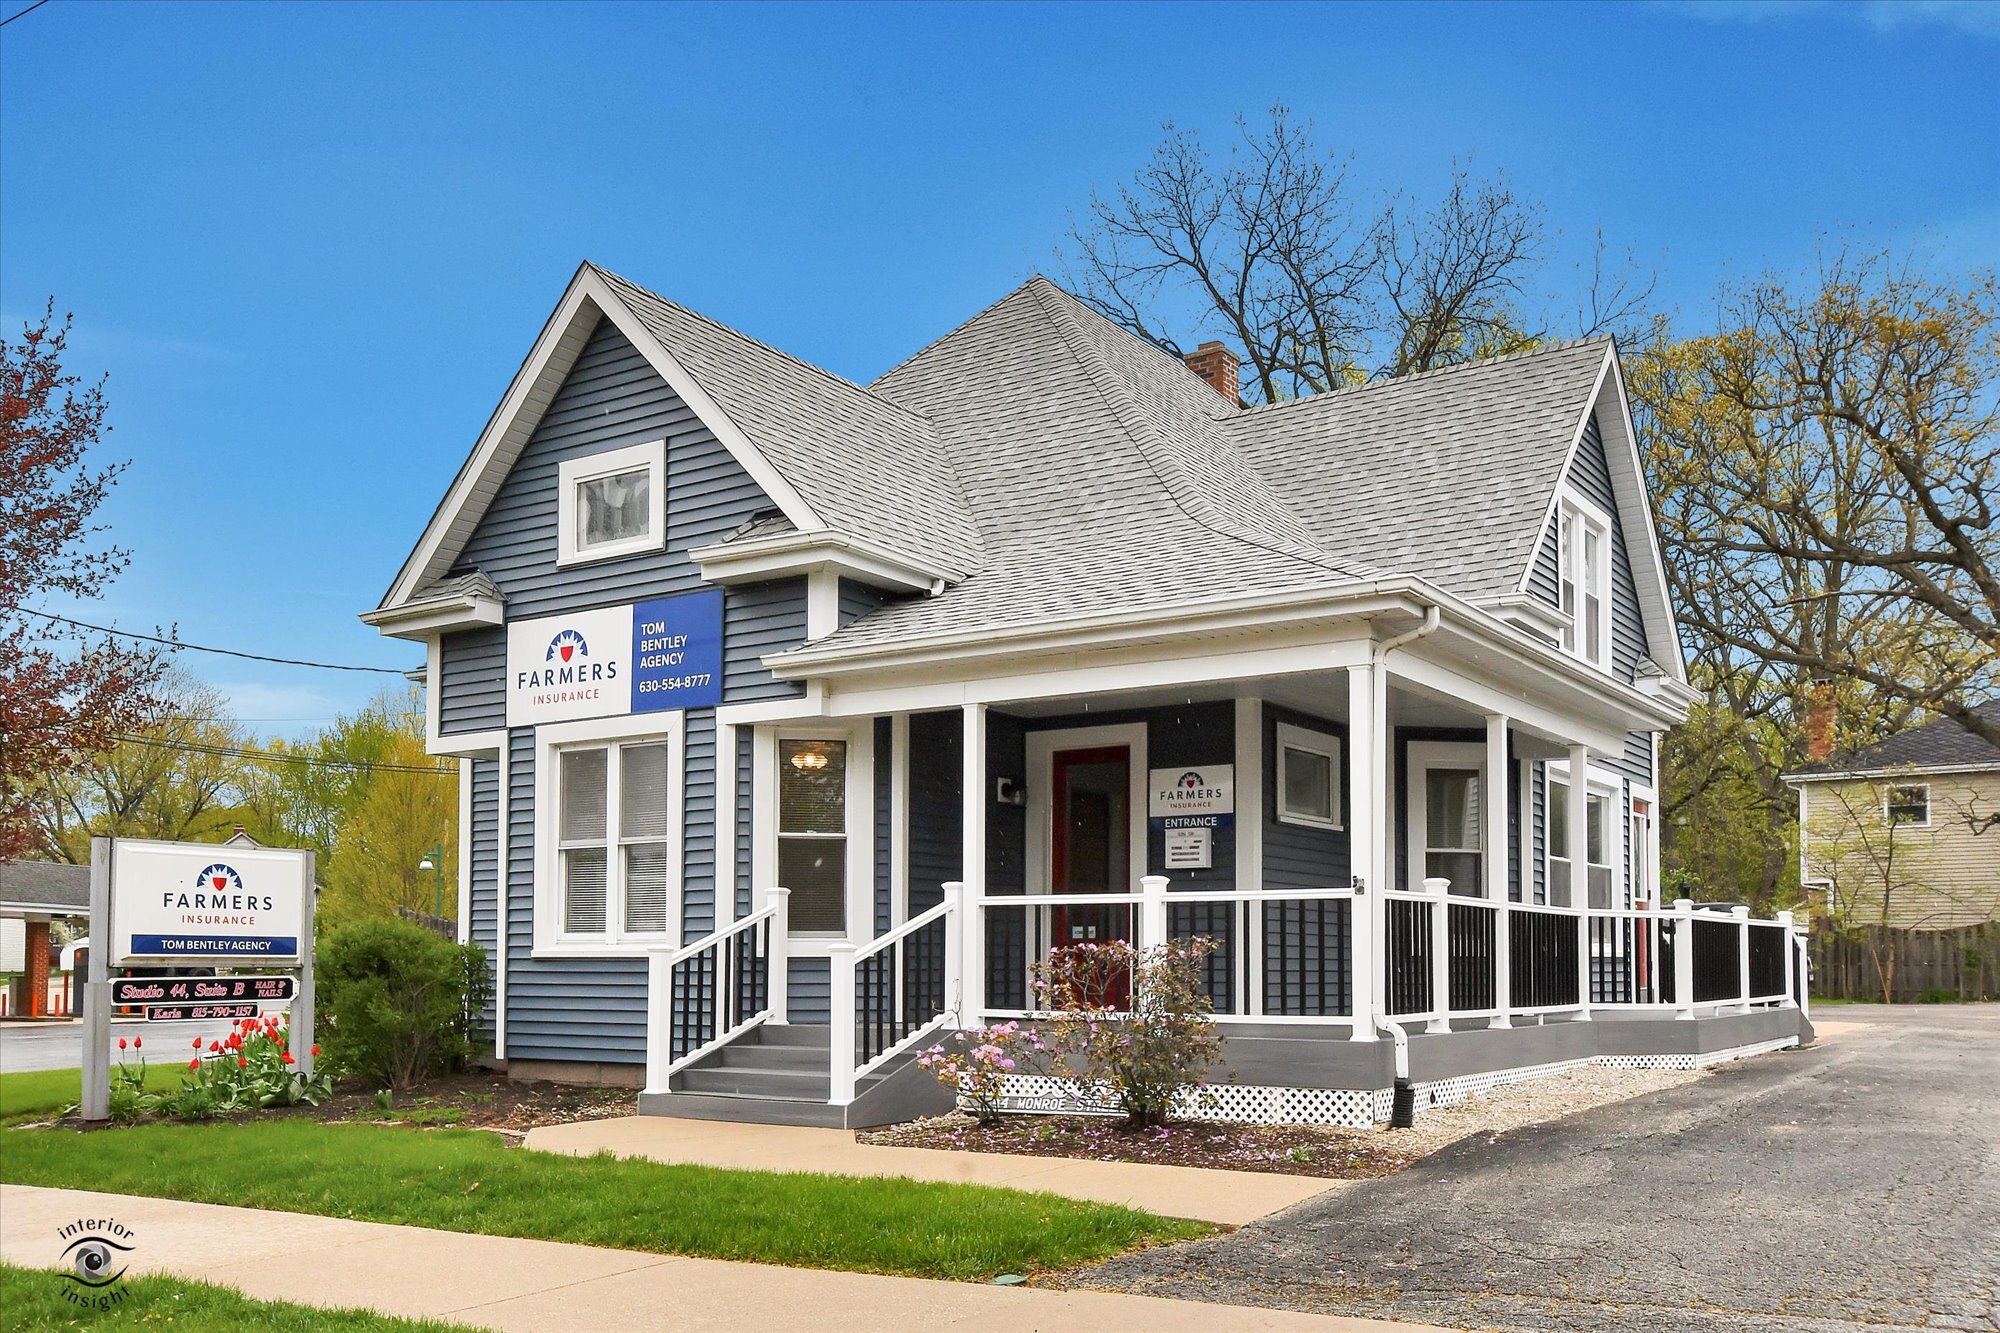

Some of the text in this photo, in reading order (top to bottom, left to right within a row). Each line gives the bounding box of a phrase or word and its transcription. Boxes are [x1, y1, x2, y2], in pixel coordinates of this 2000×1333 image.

[641, 621, 665, 636] TOM
[641, 635, 688, 652] BENTLEY
[640, 652, 685, 669] AGENCY
[518, 661, 617, 689] FARMERS
[639, 674, 711, 693] 630-554-8777
[533, 688, 600, 705] INSURANCE
[1160, 788, 1222, 801] FARMERS
[1169, 801, 1211, 809] INSURANCE
[1165, 816, 1217, 828] ENTRANCE
[164, 893, 273, 911] FARMERS
[181, 915, 255, 925] INSURANCE
[161, 940, 272, 951] TOM BENTLEY AGENCY
[121, 984, 164, 999] Studio
[195, 982, 227, 997] Suite
[233, 982, 245, 996] B
[255, 981, 276, 989] HAIR
[258, 989, 283, 997] NAILS
[1016, 1097, 1067, 1111] MONROE
